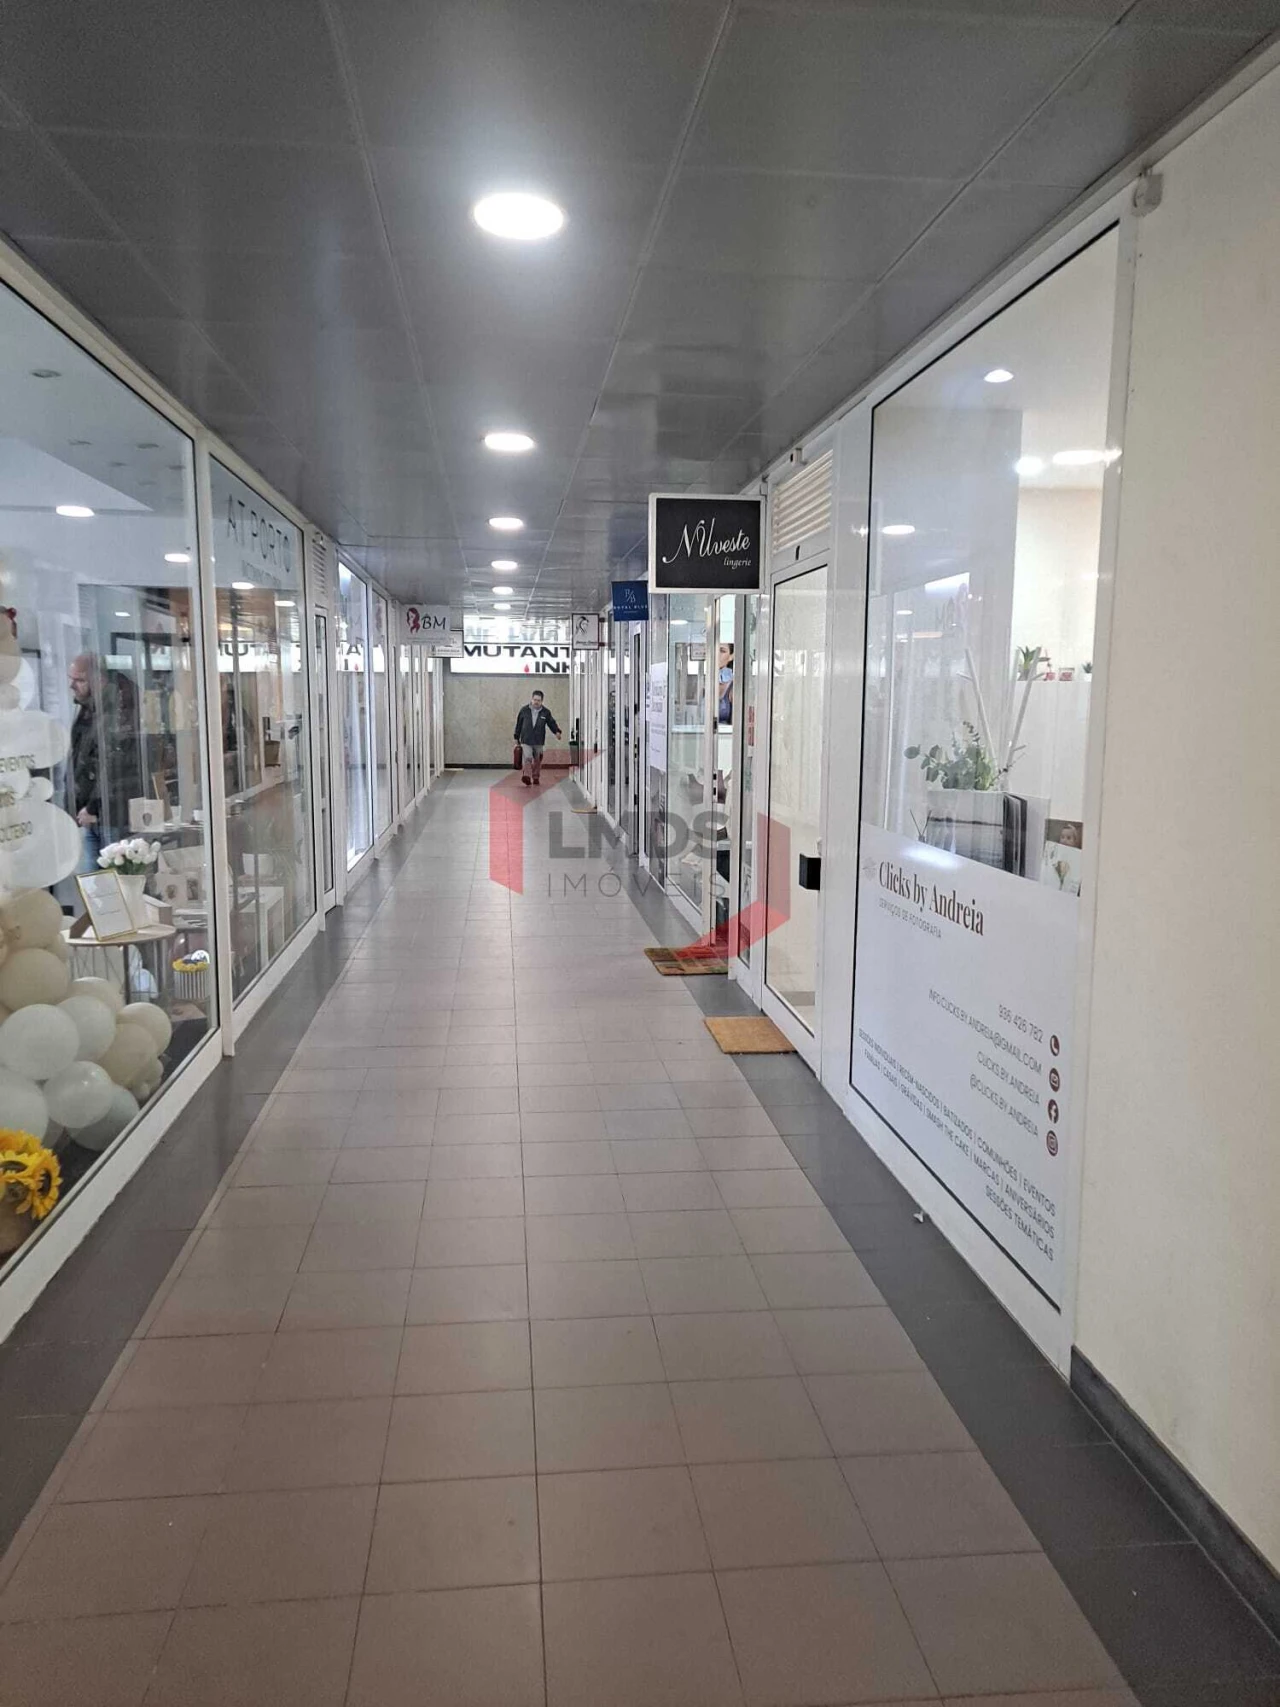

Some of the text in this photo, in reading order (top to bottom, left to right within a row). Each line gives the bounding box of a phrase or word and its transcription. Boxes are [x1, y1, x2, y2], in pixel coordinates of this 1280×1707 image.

[723, 556, 752, 570] lingerie
[879, 861, 984, 936] Clicks by Andreia
[954, 1134, 969, 1157] CAKE
[973, 1152, 999, 1185] MARCAS
[1023, 1177, 1055, 1216] EVENTOS
